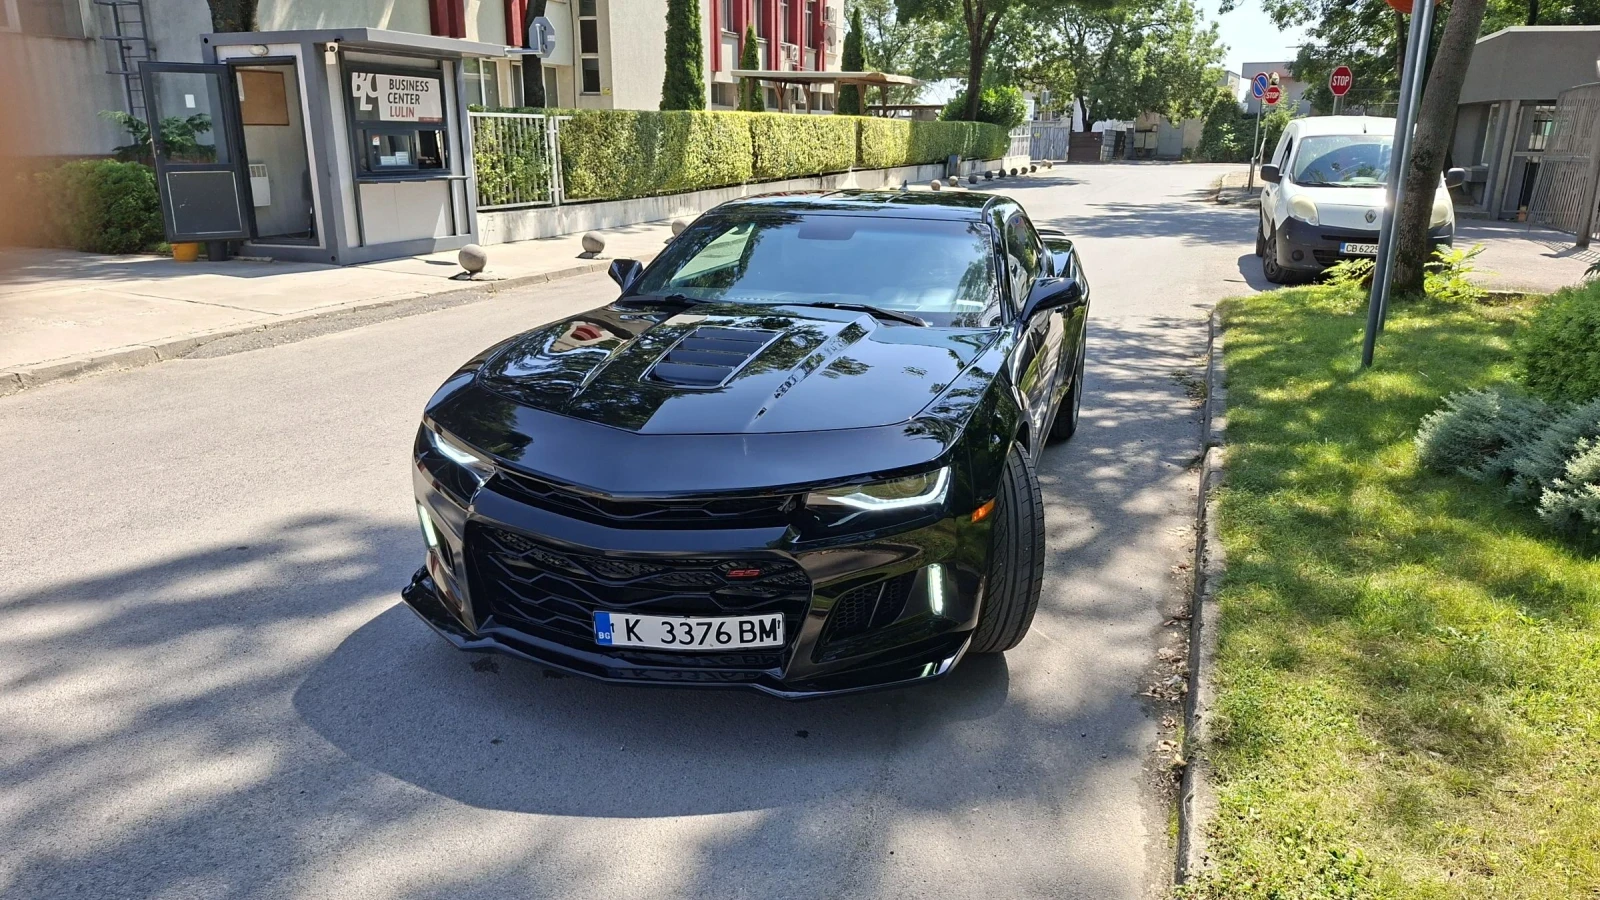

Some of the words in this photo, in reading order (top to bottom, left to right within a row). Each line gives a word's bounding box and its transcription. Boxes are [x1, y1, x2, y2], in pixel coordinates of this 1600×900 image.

[389, 79, 429, 92] BUSINESS
[1333, 76, 1350, 86] STOP
[387, 93, 420, 105] CENTER
[1266, 91, 1280, 99] STOP
[390, 106, 415, 118] LULIN
[1346, 244, 1358, 253] CB
[598, 631, 611, 640] BG
[625, 618, 644, 643] K
[660, 621, 732, 646] 3376
[738, 618, 778, 644] BM
